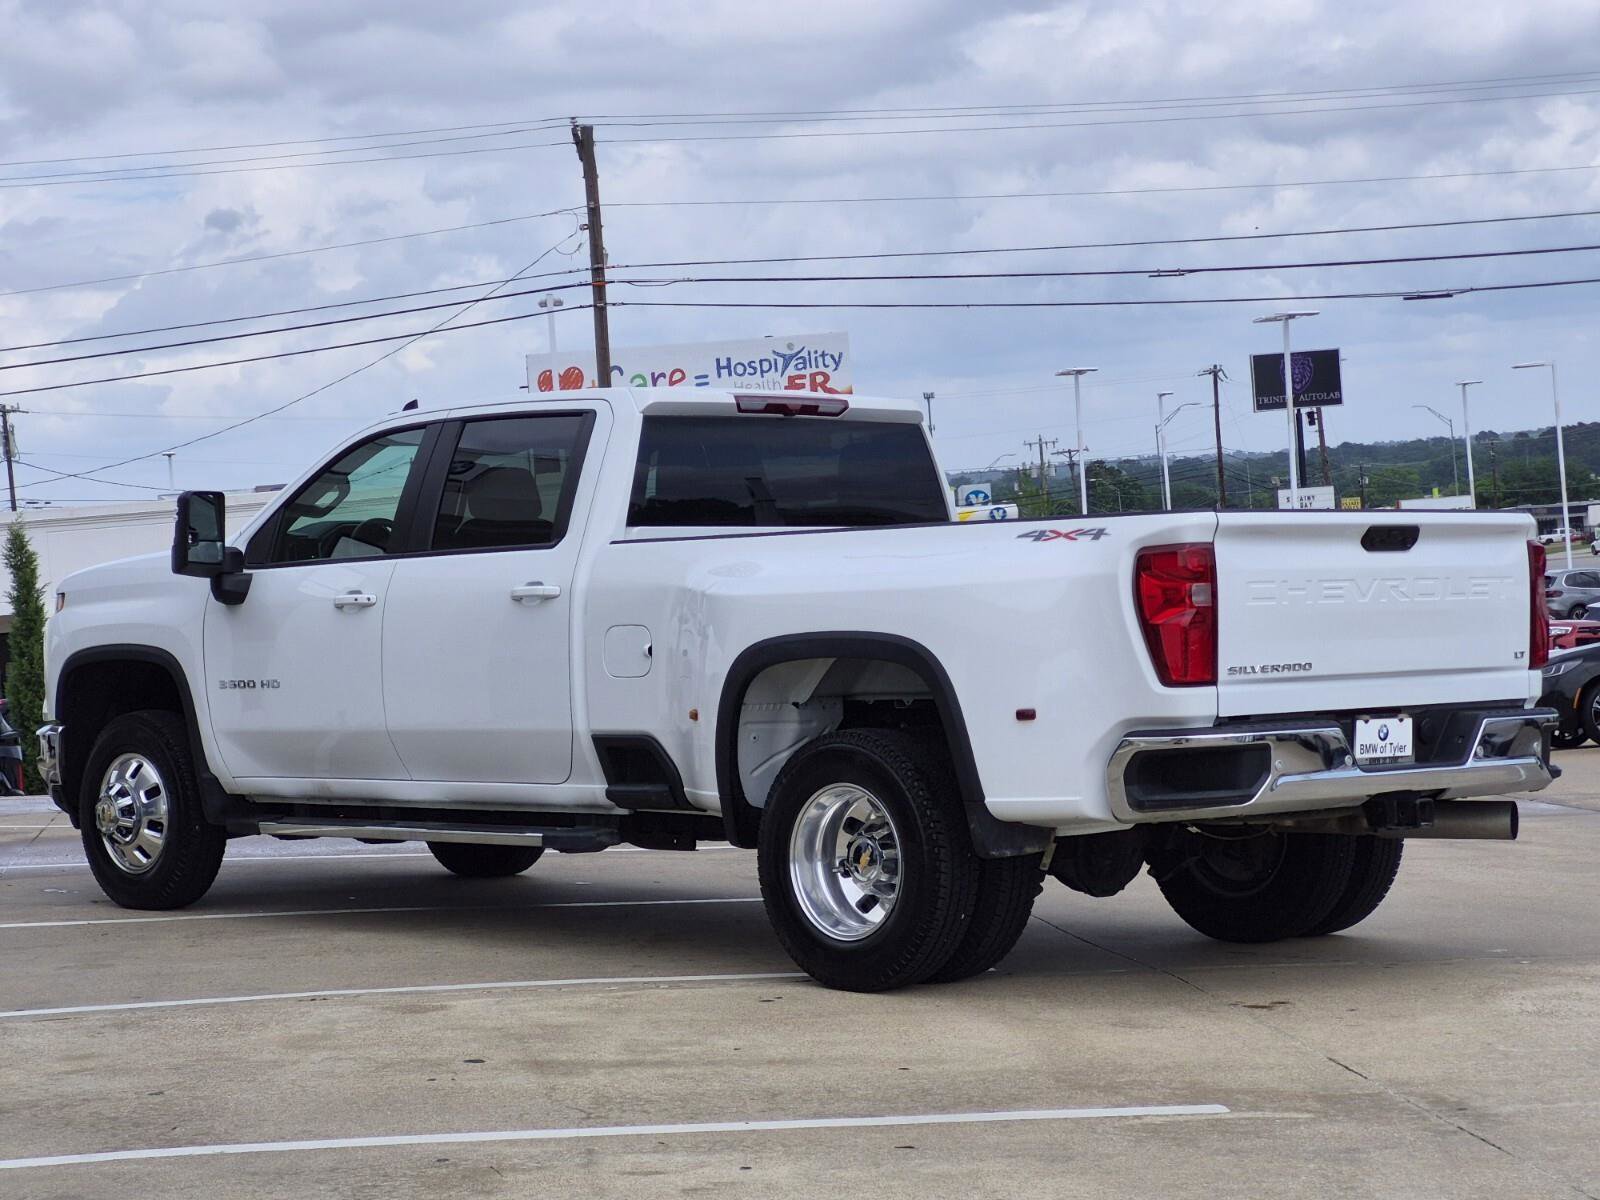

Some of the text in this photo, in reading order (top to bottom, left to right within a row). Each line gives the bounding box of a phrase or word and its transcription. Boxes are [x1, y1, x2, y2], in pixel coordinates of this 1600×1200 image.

[784, 371, 853, 394] ER
[1257, 391, 1341, 404] TRINIT AUTOLAB
[1016, 527, 1111, 542] 4X4
[1246, 576, 1514, 605] CHEVROLET
[1514, 651, 1526, 660] LT
[1227, 662, 1313, 676] SILVERADO
[219, 679, 280, 690] 3500 HD
[1360, 742, 1407, 756] BMW of Tyler
